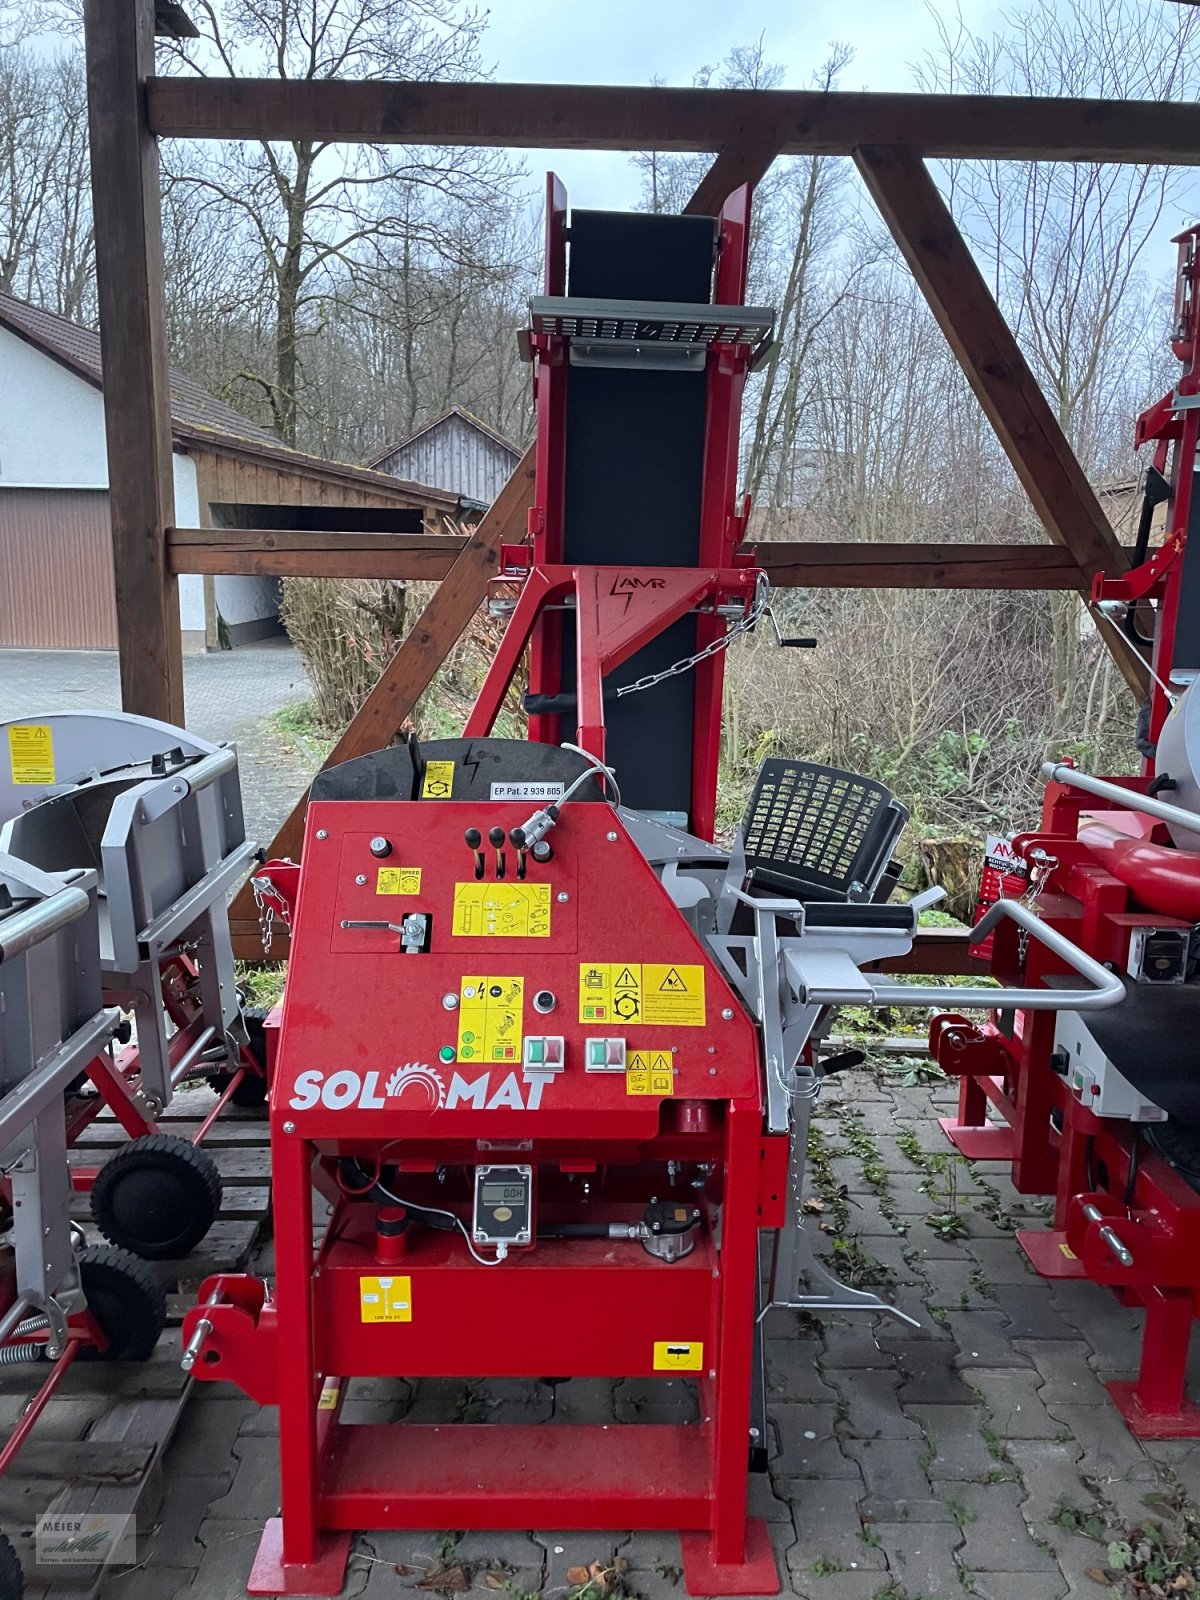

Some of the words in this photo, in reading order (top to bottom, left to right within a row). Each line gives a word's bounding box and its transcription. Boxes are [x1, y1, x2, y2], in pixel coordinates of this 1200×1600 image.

[494, 787, 504, 796] EP.
[507, 787, 521, 796] Pat.
[523, 788, 528, 796] 2
[530, 788, 545, 796] 939
[547, 788, 561, 796] 805
